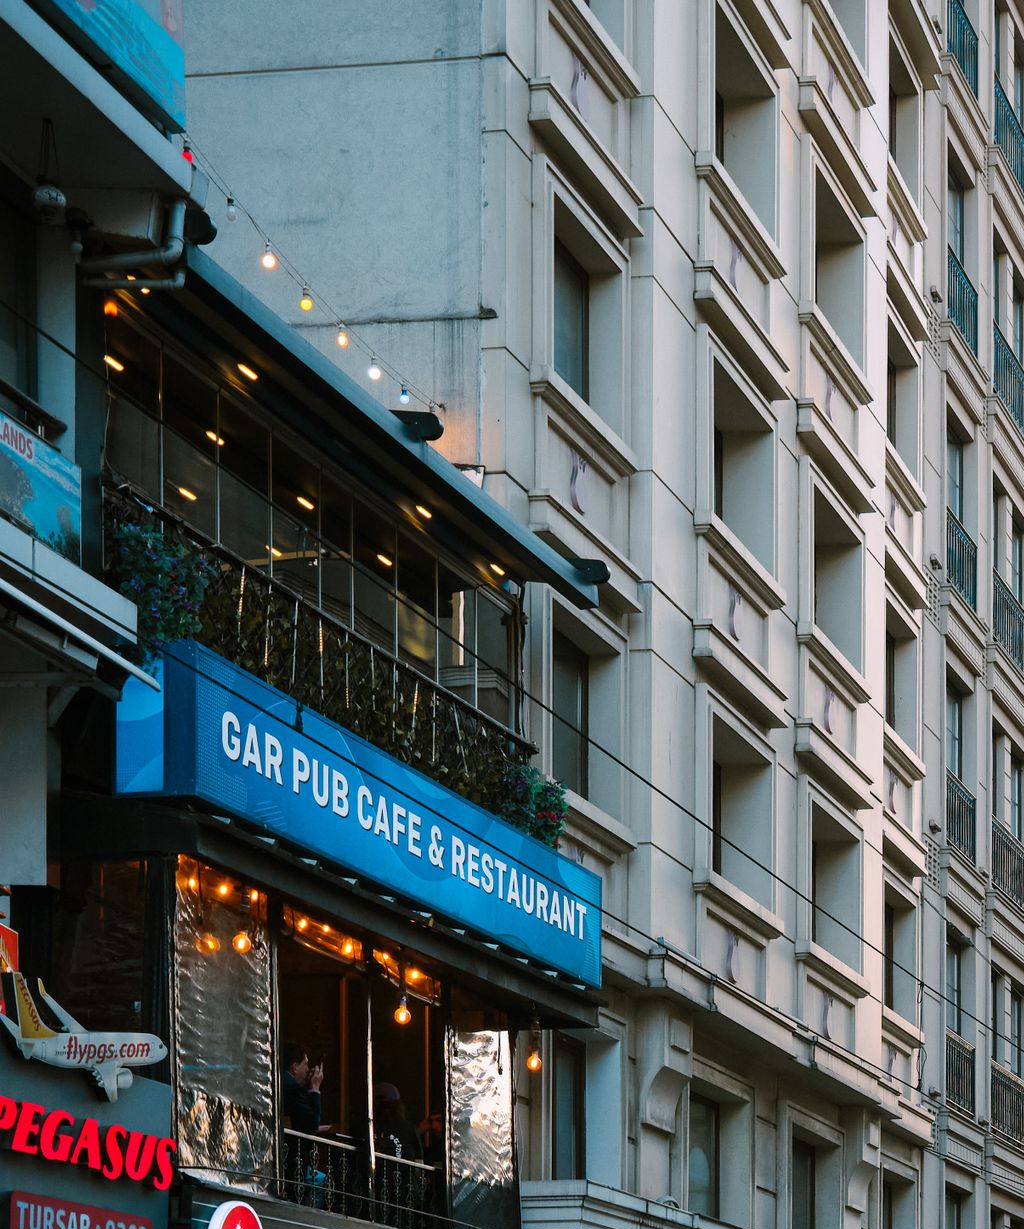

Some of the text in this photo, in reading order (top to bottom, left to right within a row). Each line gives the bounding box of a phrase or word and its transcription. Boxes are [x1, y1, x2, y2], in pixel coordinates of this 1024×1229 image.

[222, 711, 587, 941] GAR PUB CAFE & RESTAURANT
[66, 1036, 150, 1064] flypgs.com
[0, 1095, 177, 1191] PEGASUS
